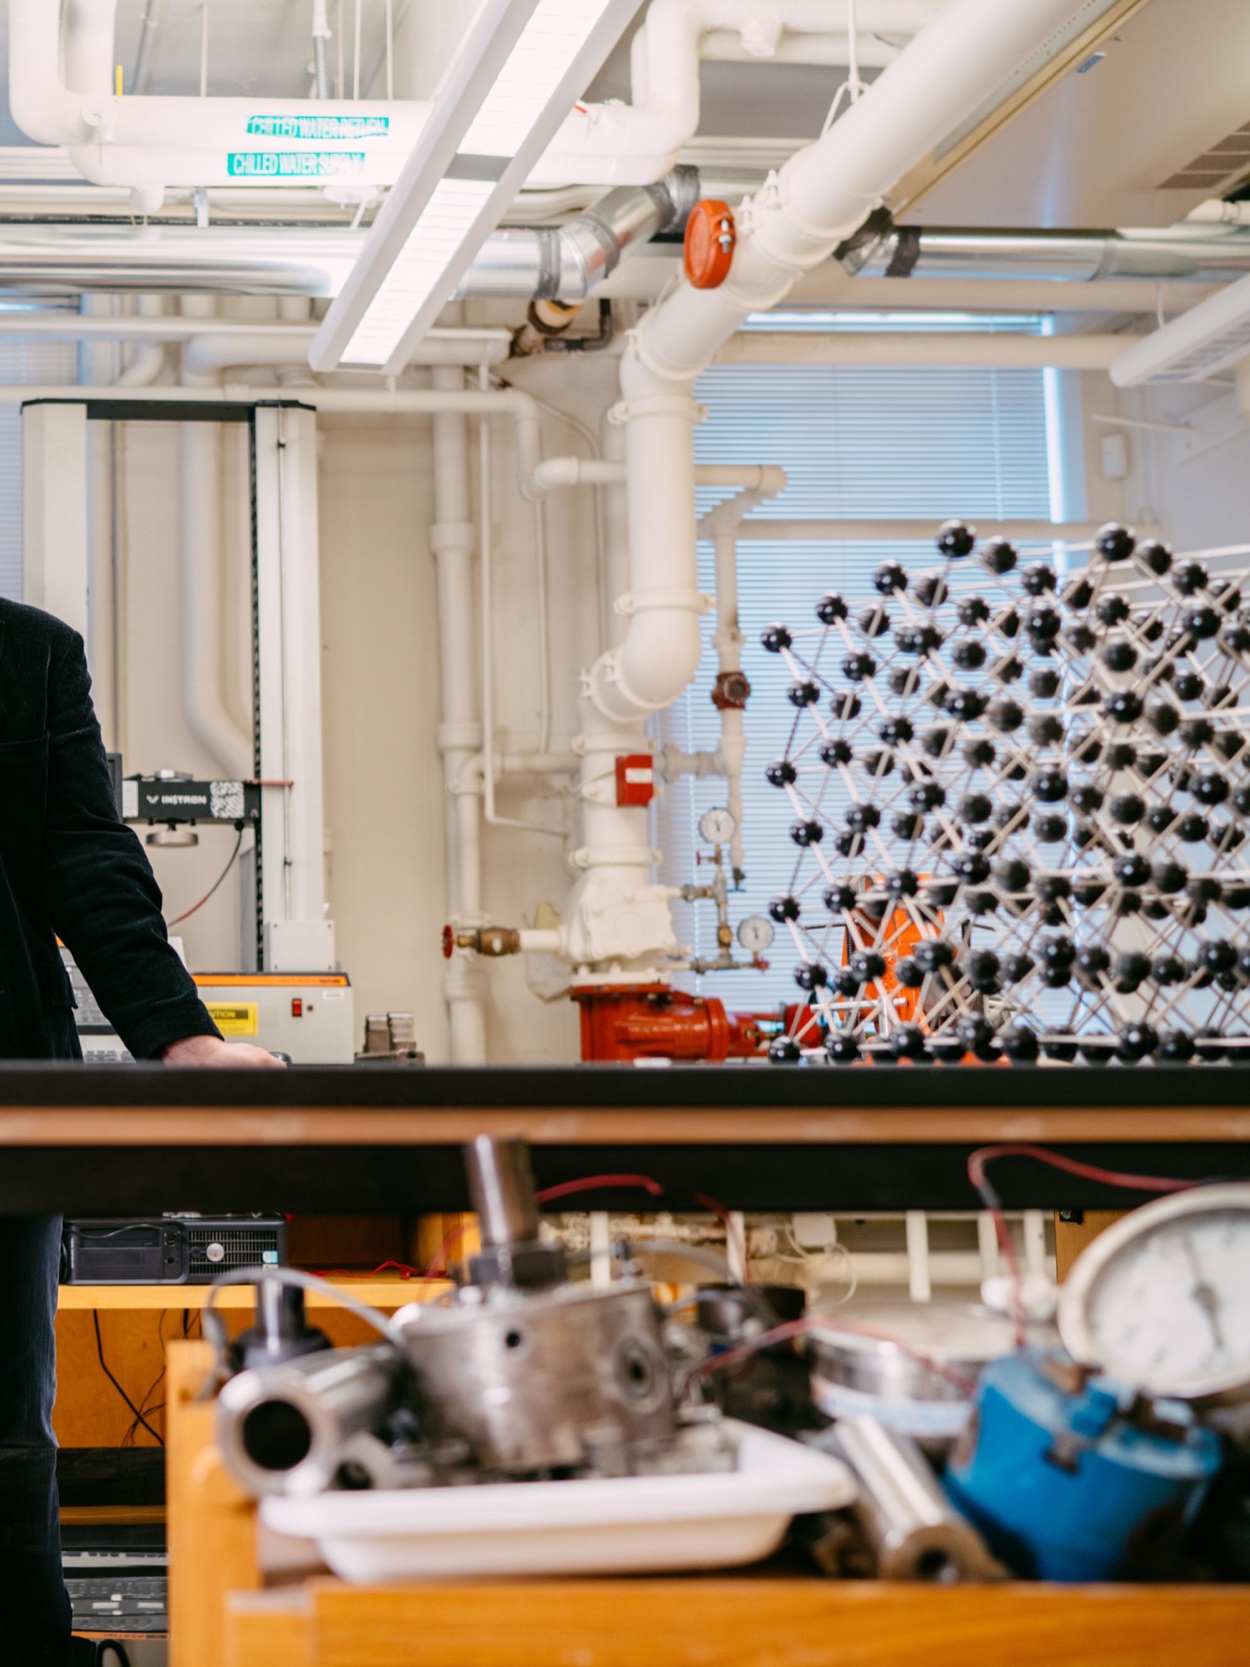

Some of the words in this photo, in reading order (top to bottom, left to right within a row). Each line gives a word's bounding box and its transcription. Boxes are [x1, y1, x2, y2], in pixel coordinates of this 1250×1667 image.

[251, 116, 297, 137] CHILLED
[299, 117, 338, 138] WATER
[233, 153, 278, 174] CHILLED
[279, 153, 318, 175] WATER
[318, 153, 364, 174] SUPPLY
[161, 795, 207, 805] INSTRON
